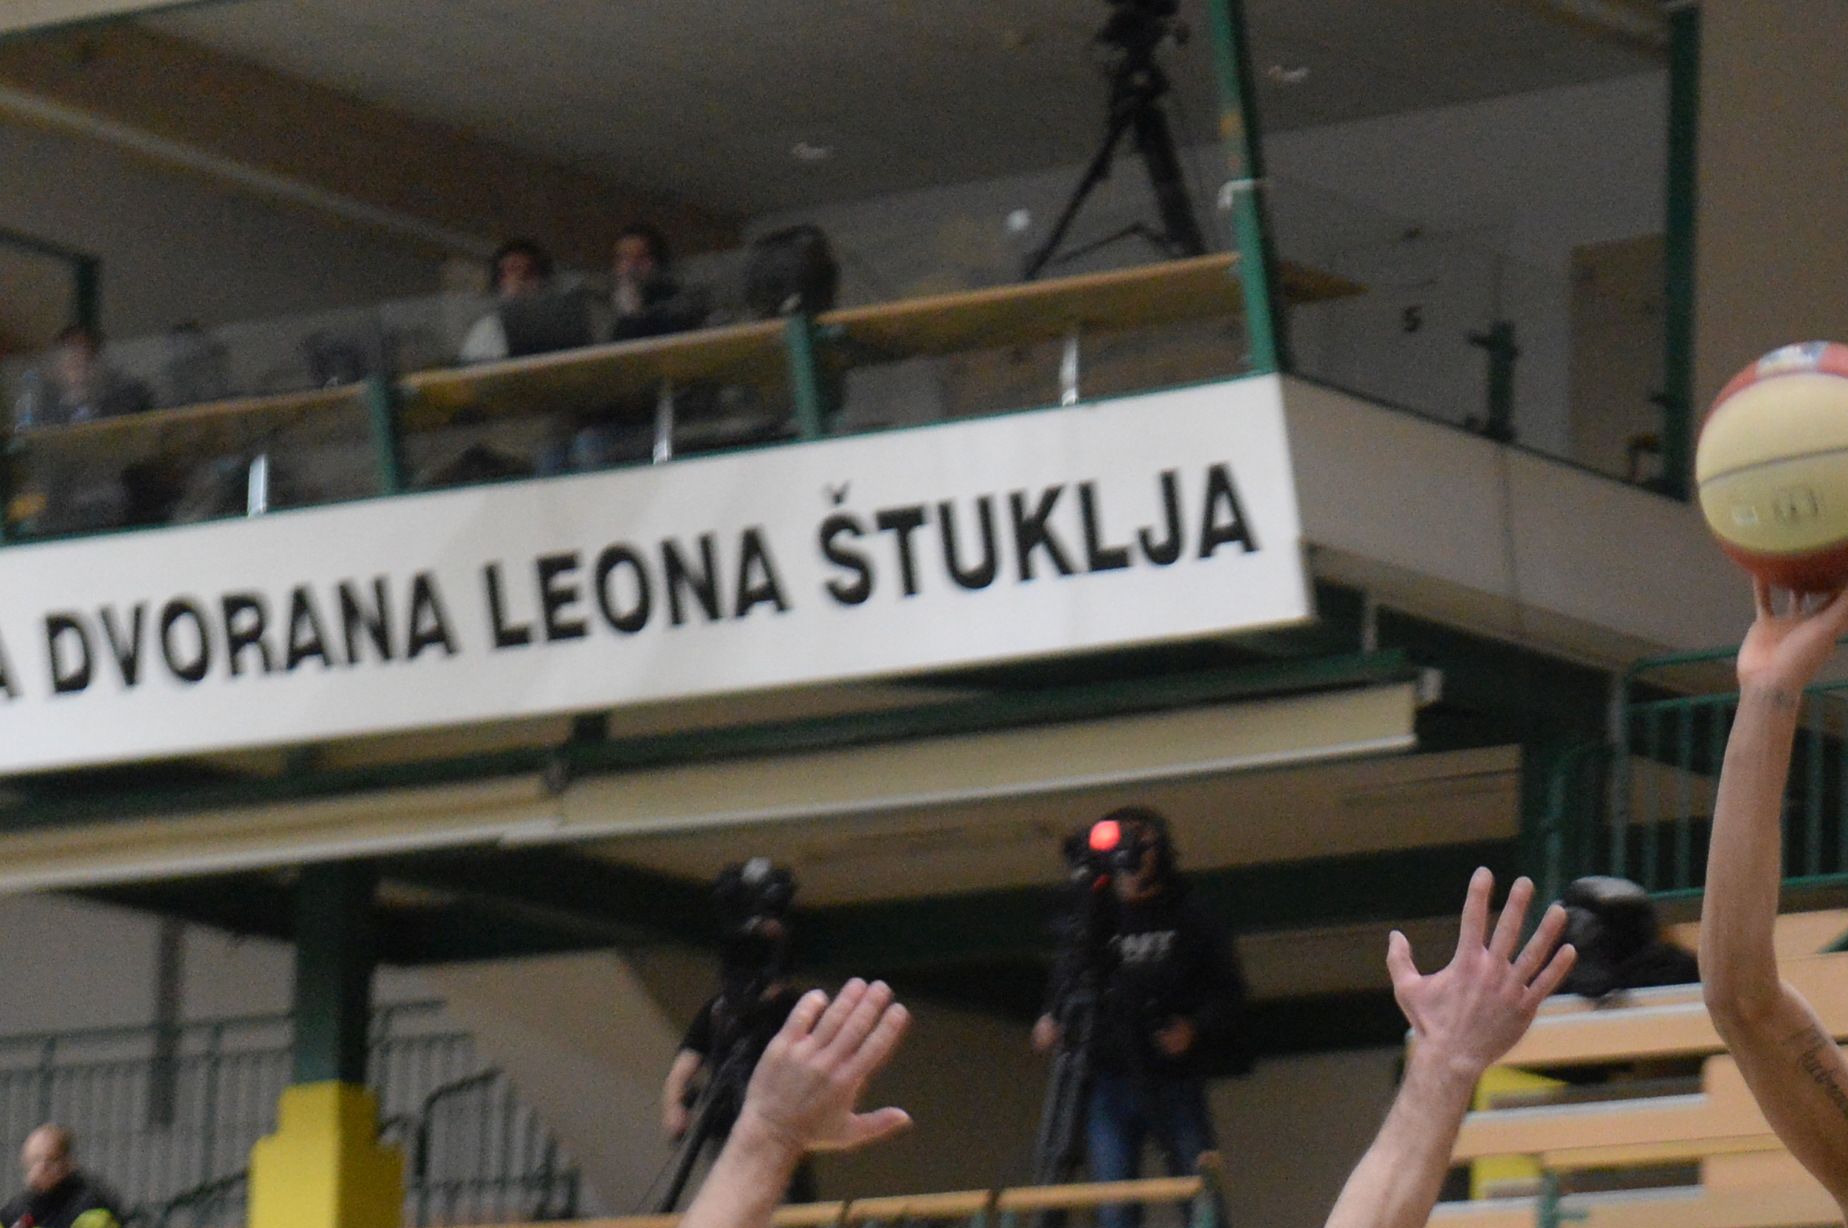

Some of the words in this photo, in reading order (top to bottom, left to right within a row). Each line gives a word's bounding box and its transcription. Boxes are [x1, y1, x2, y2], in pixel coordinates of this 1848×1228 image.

[44, 567, 458, 694] DVORANA
[482, 523, 791, 650] LEONA
[817, 460, 1259, 606] ŠTUKLJA
